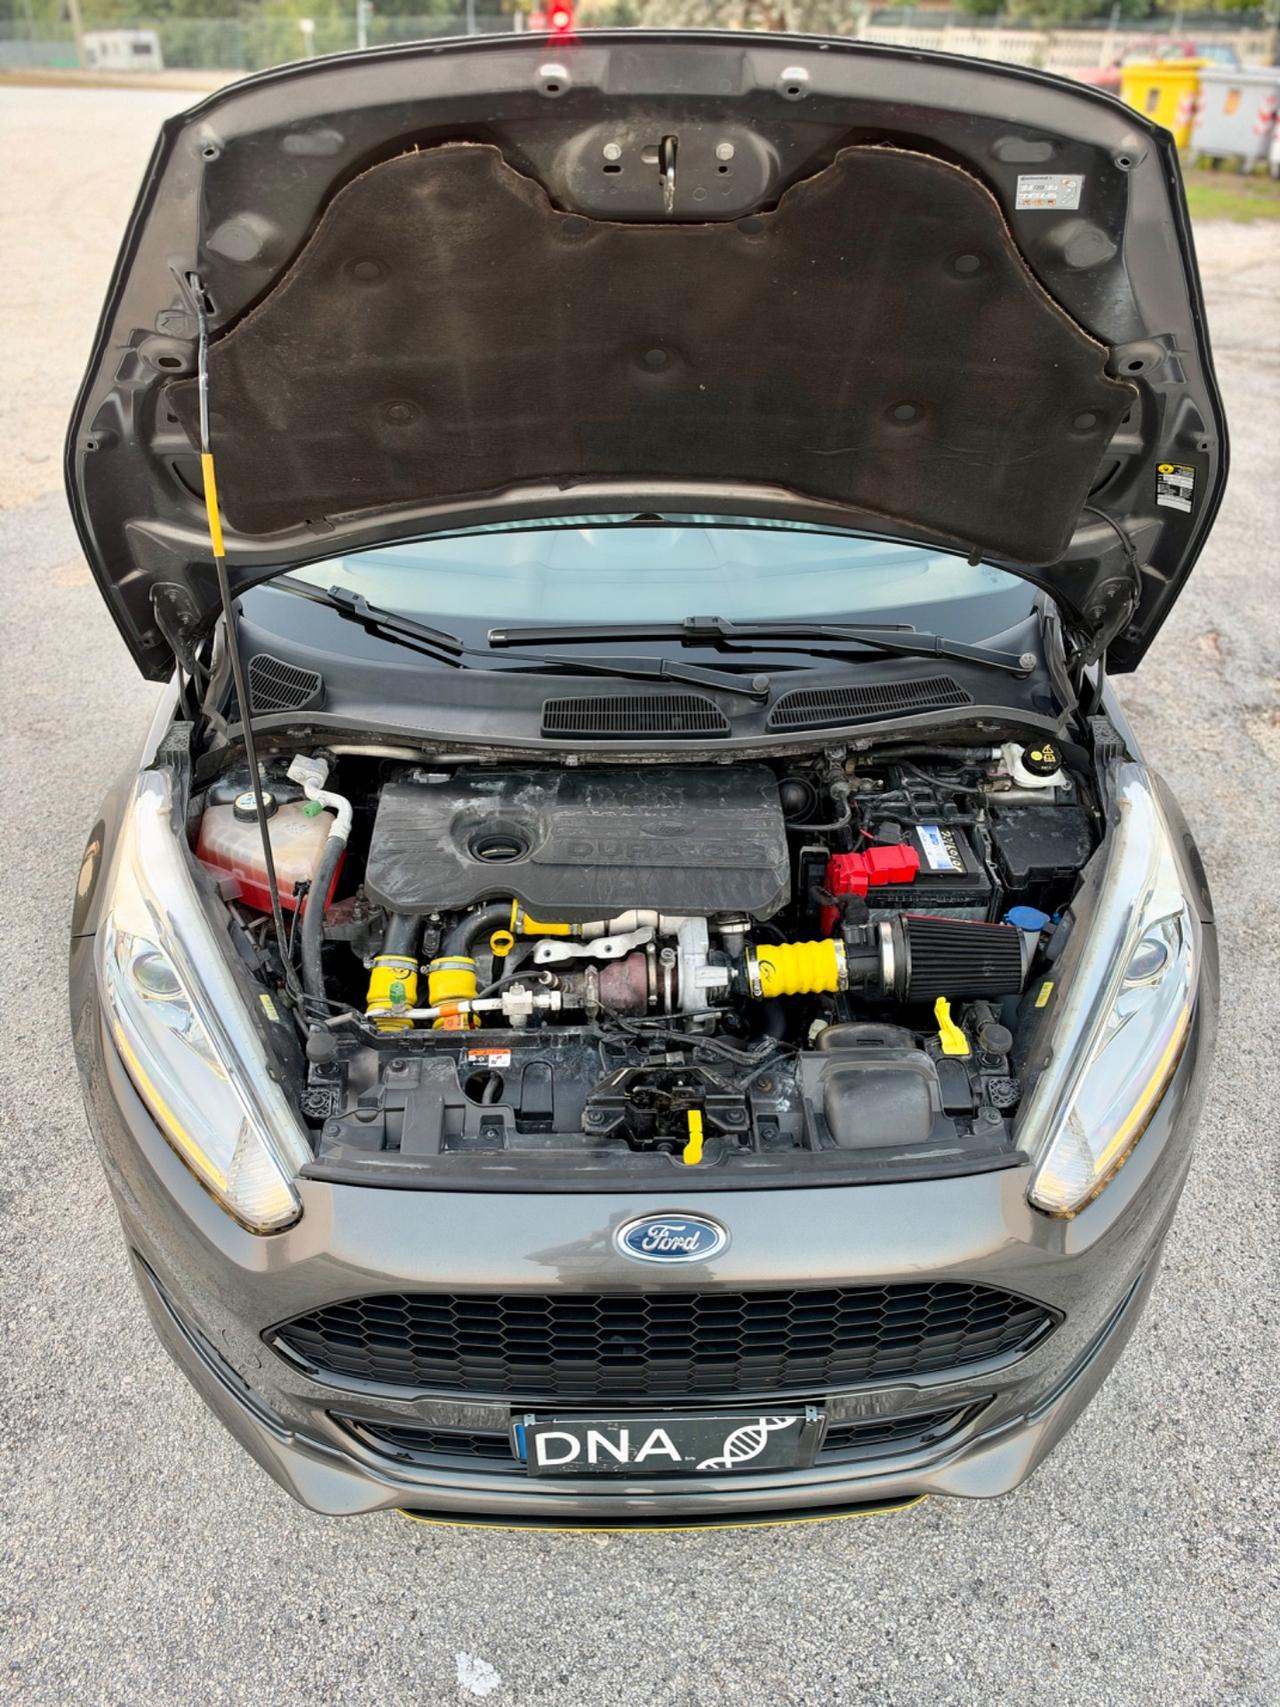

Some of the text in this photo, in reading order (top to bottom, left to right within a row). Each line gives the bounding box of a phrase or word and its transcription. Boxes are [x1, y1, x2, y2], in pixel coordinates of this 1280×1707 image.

[567, 841, 767, 863] DURAO
[641, 1224, 701, 1251] Ford
[534, 1428, 682, 1467] DNA
